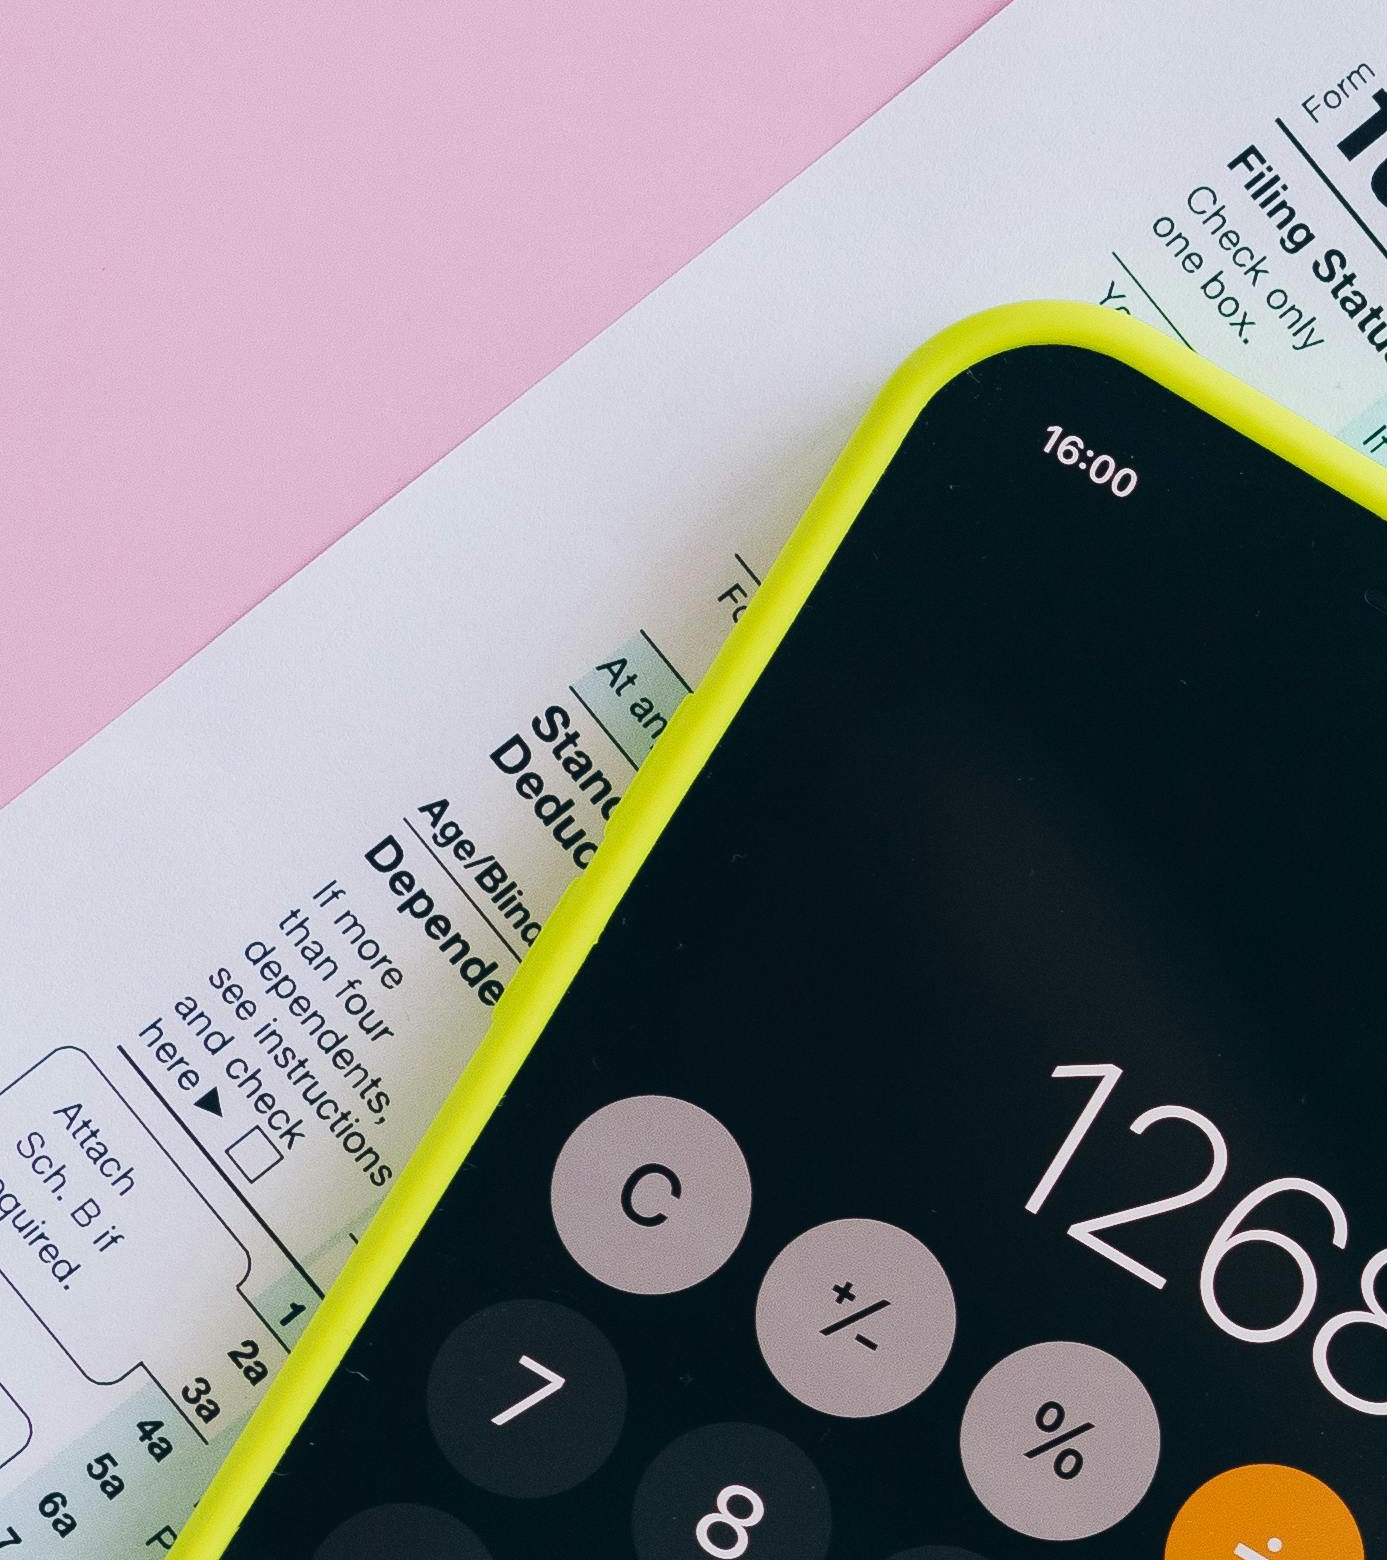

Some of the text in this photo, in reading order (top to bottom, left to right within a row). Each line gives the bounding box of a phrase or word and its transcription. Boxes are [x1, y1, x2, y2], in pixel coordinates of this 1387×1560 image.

[1300, 62, 1377, 124] Form
[1226, 143, 1317, 256] Filing
[1151, 215, 1257, 346] one box.
[1186, 185, 1326, 352] Check only
[1042, 424, 1139, 499] 16:00
[278, 907, 396, 1043] than four
[312, 878, 405, 991] If more
[138, 1016, 201, 1092] here
[173, 995, 307, 1151] and check
[207, 966, 394, 1188] see instructions
[243, 940, 392, 1126] dependents,
[15, 1130, 126, 1254] Sch. B if
[51, 1102, 136, 1198] Attach
[620, 1162, 682, 1228] C
[180, 1376, 222, 1426] 3a
[226, 1338, 270, 1388] 2a
[490, 1354, 566, 1426] 7
[85, 1451, 126, 1502] 5a
[1023, 1400, 1095, 1481] %
[695, 1484, 765, 1560] 8
